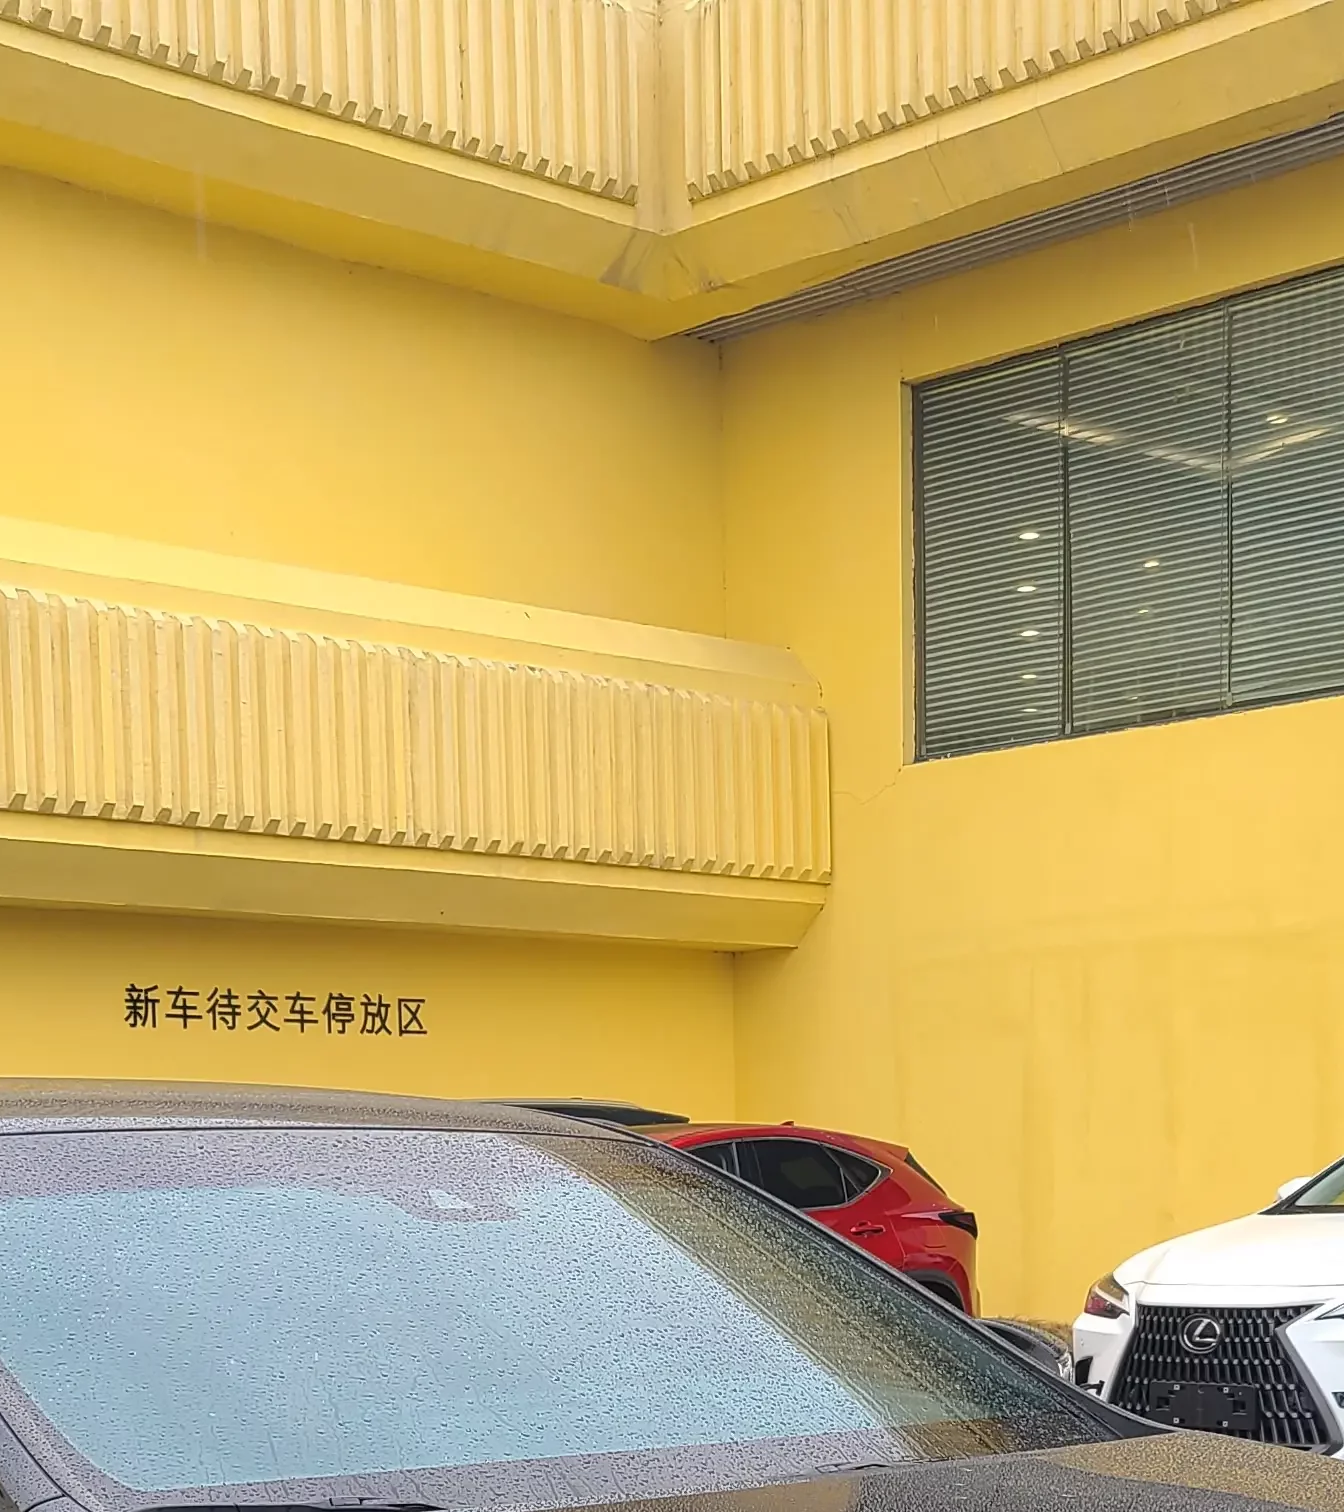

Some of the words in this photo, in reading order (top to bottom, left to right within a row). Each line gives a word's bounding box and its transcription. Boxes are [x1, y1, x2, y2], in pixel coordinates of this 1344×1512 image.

[123, 983, 428, 1036] 新车待交车停放区
